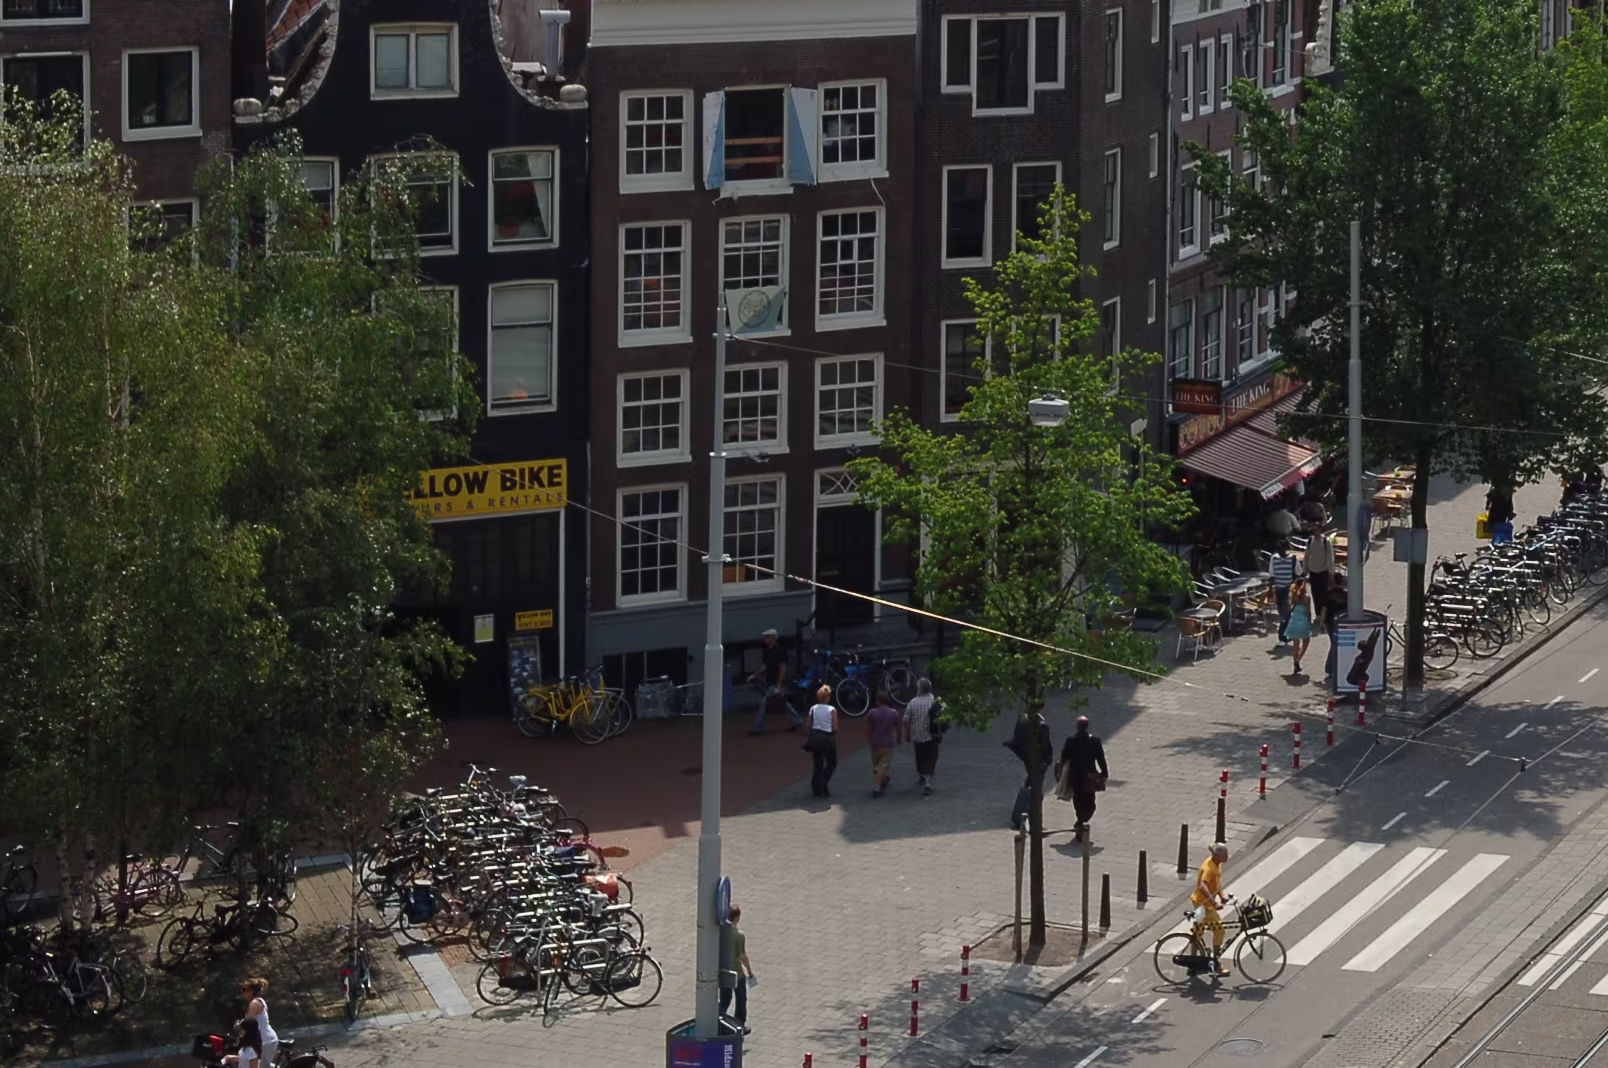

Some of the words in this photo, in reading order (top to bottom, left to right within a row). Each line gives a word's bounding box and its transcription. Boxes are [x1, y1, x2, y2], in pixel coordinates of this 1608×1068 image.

[1176, 392, 1192, 402] THE
[1194, 393, 1217, 404] KING
[1231, 392, 1249, 412] THE
[1249, 381, 1270, 404] KING
[500, 464, 563, 492] BIKE
[488, 492, 563, 508] RENTALS
